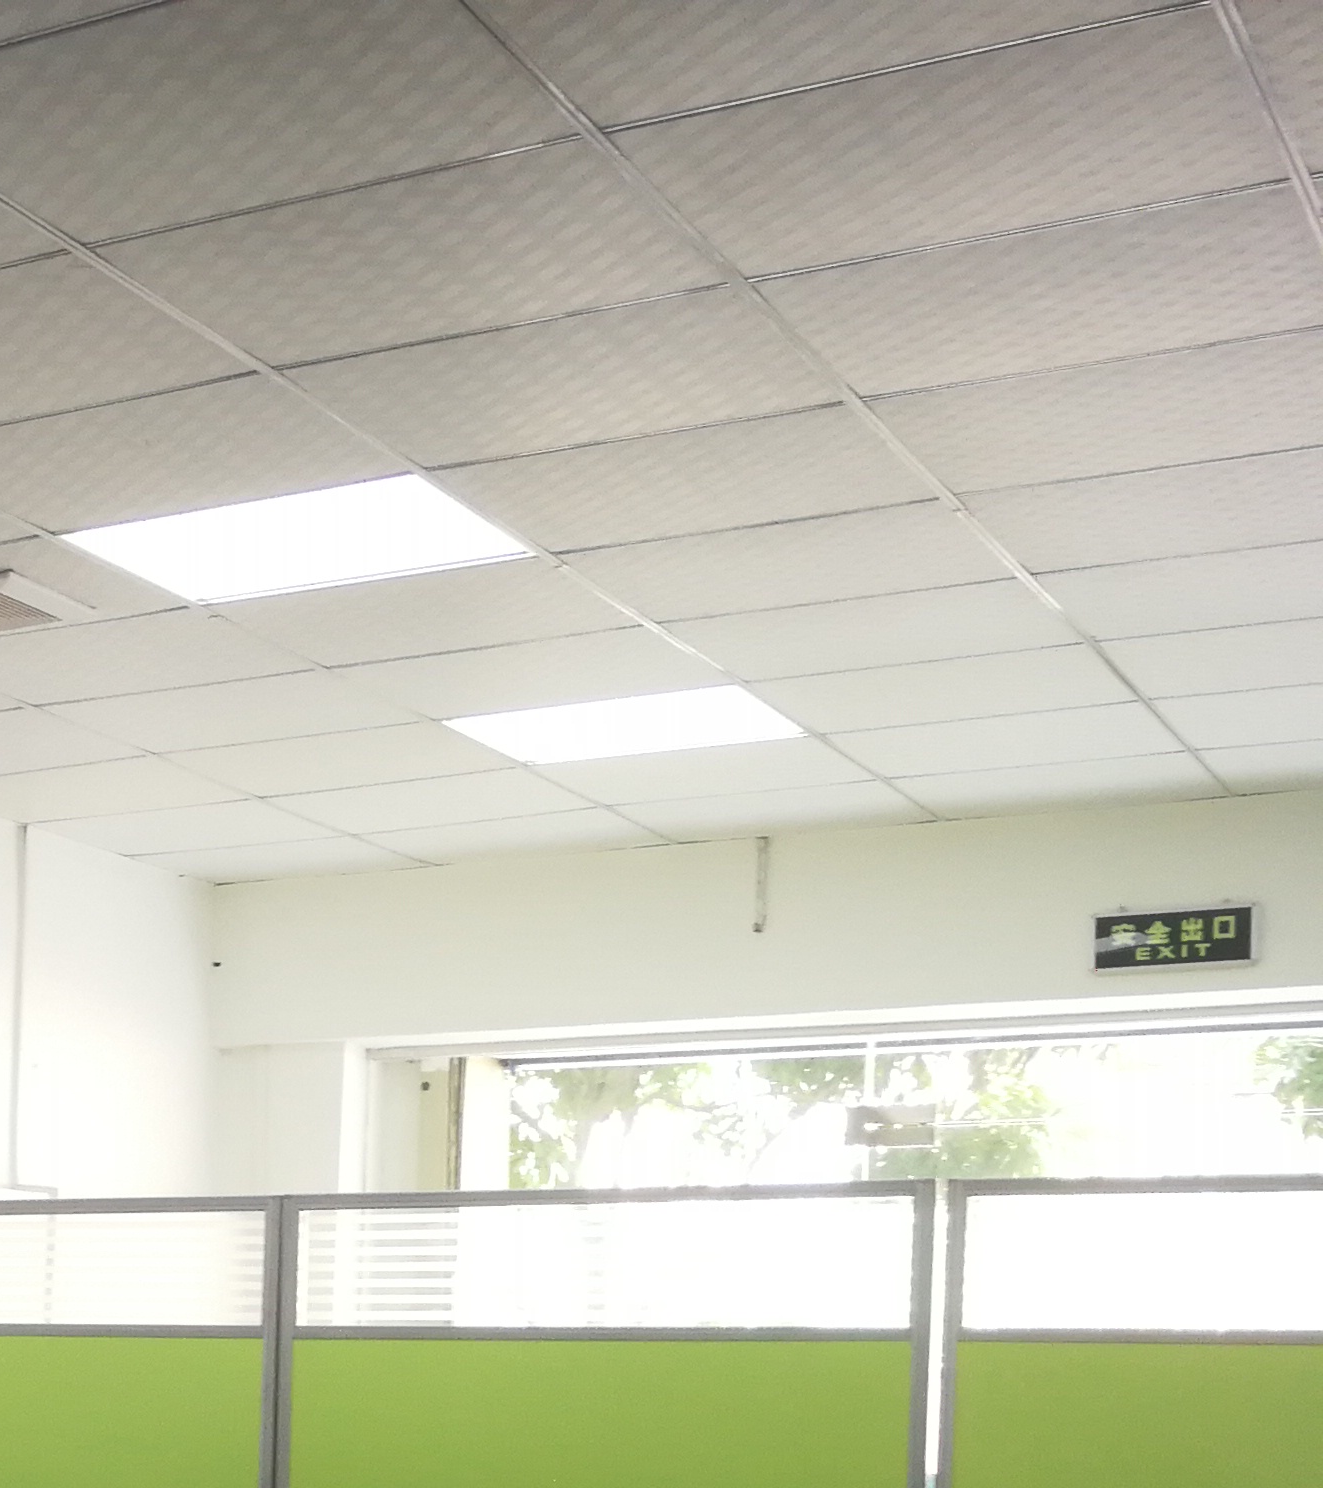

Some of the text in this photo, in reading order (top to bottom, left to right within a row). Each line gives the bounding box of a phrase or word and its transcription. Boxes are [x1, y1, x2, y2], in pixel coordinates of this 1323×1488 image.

[1110, 915, 1236, 946] 安全出口
[1135, 943, 1212, 961] EXIT
